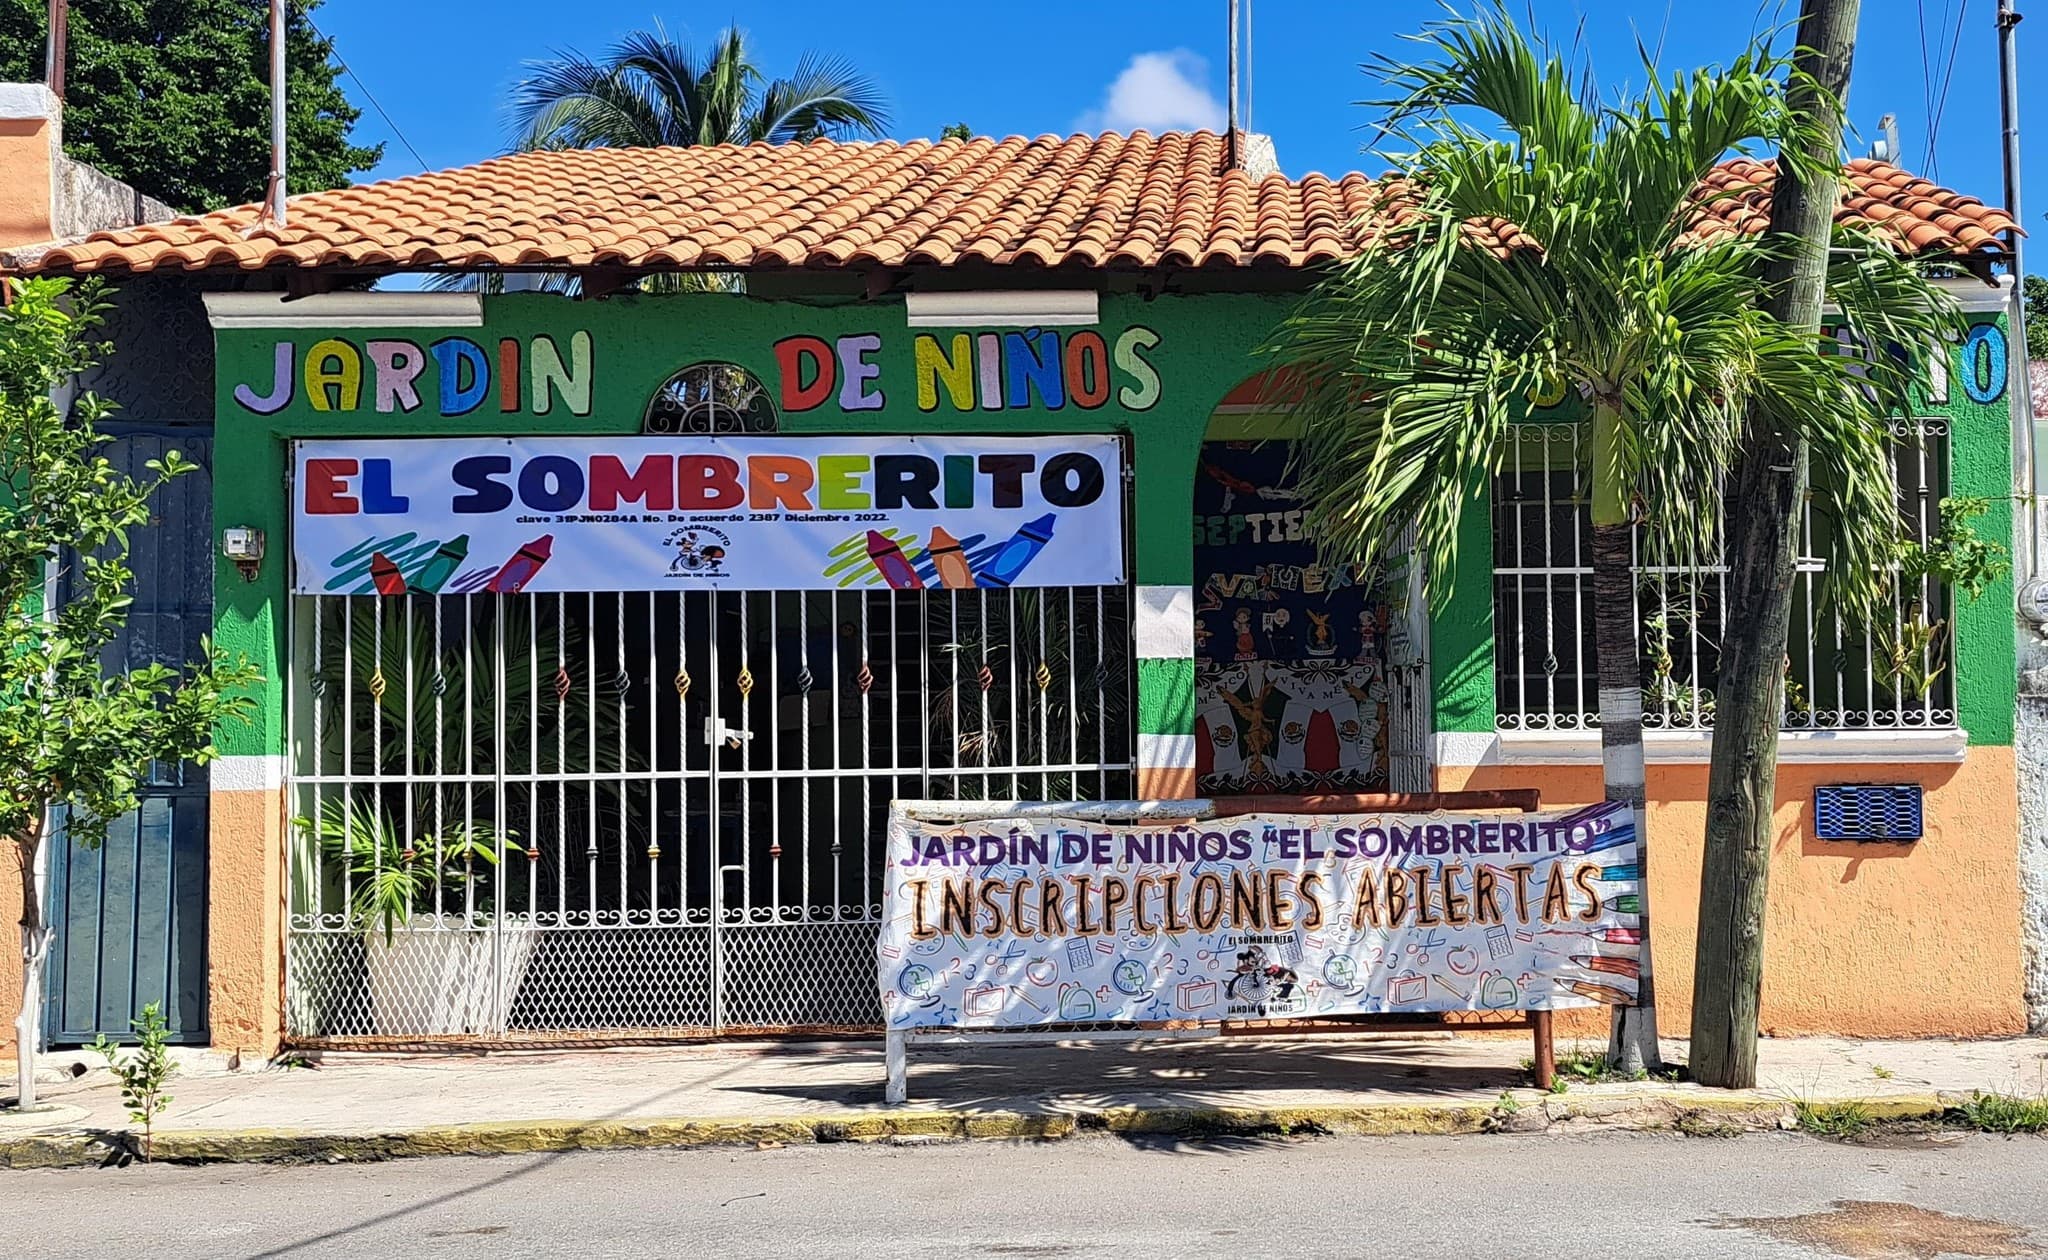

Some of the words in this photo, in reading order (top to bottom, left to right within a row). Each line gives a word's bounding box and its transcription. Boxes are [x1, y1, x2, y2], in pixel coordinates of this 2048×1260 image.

[233, 331, 595, 416] JARDIN
[774, 334, 886, 413] DE
[914, 325, 1163, 412] NIÑOS
[305, 457, 410, 514] EL
[451, 451, 1105, 513] SOMBRERITO
[516, 515, 550, 523] clave
[641, 514, 663, 523] No.
[668, 514, 685, 522] De
[689, 514, 744, 522] acuerdo
[749, 513, 780, 522] 2387
[784, 513, 850, 522] Diciembre
[662, 538, 673, 546] EL
[670, 524, 731, 546] SOMBRERITO
[900, 827, 1049, 867] JARDÍN
[1061, 833, 1113, 864] DE
[1125, 826, 1253, 865] NIÑOS
[907, 868, 1326, 940] INSCRIPCIONES
[1351, 860, 1604, 932] ABIERTAS
